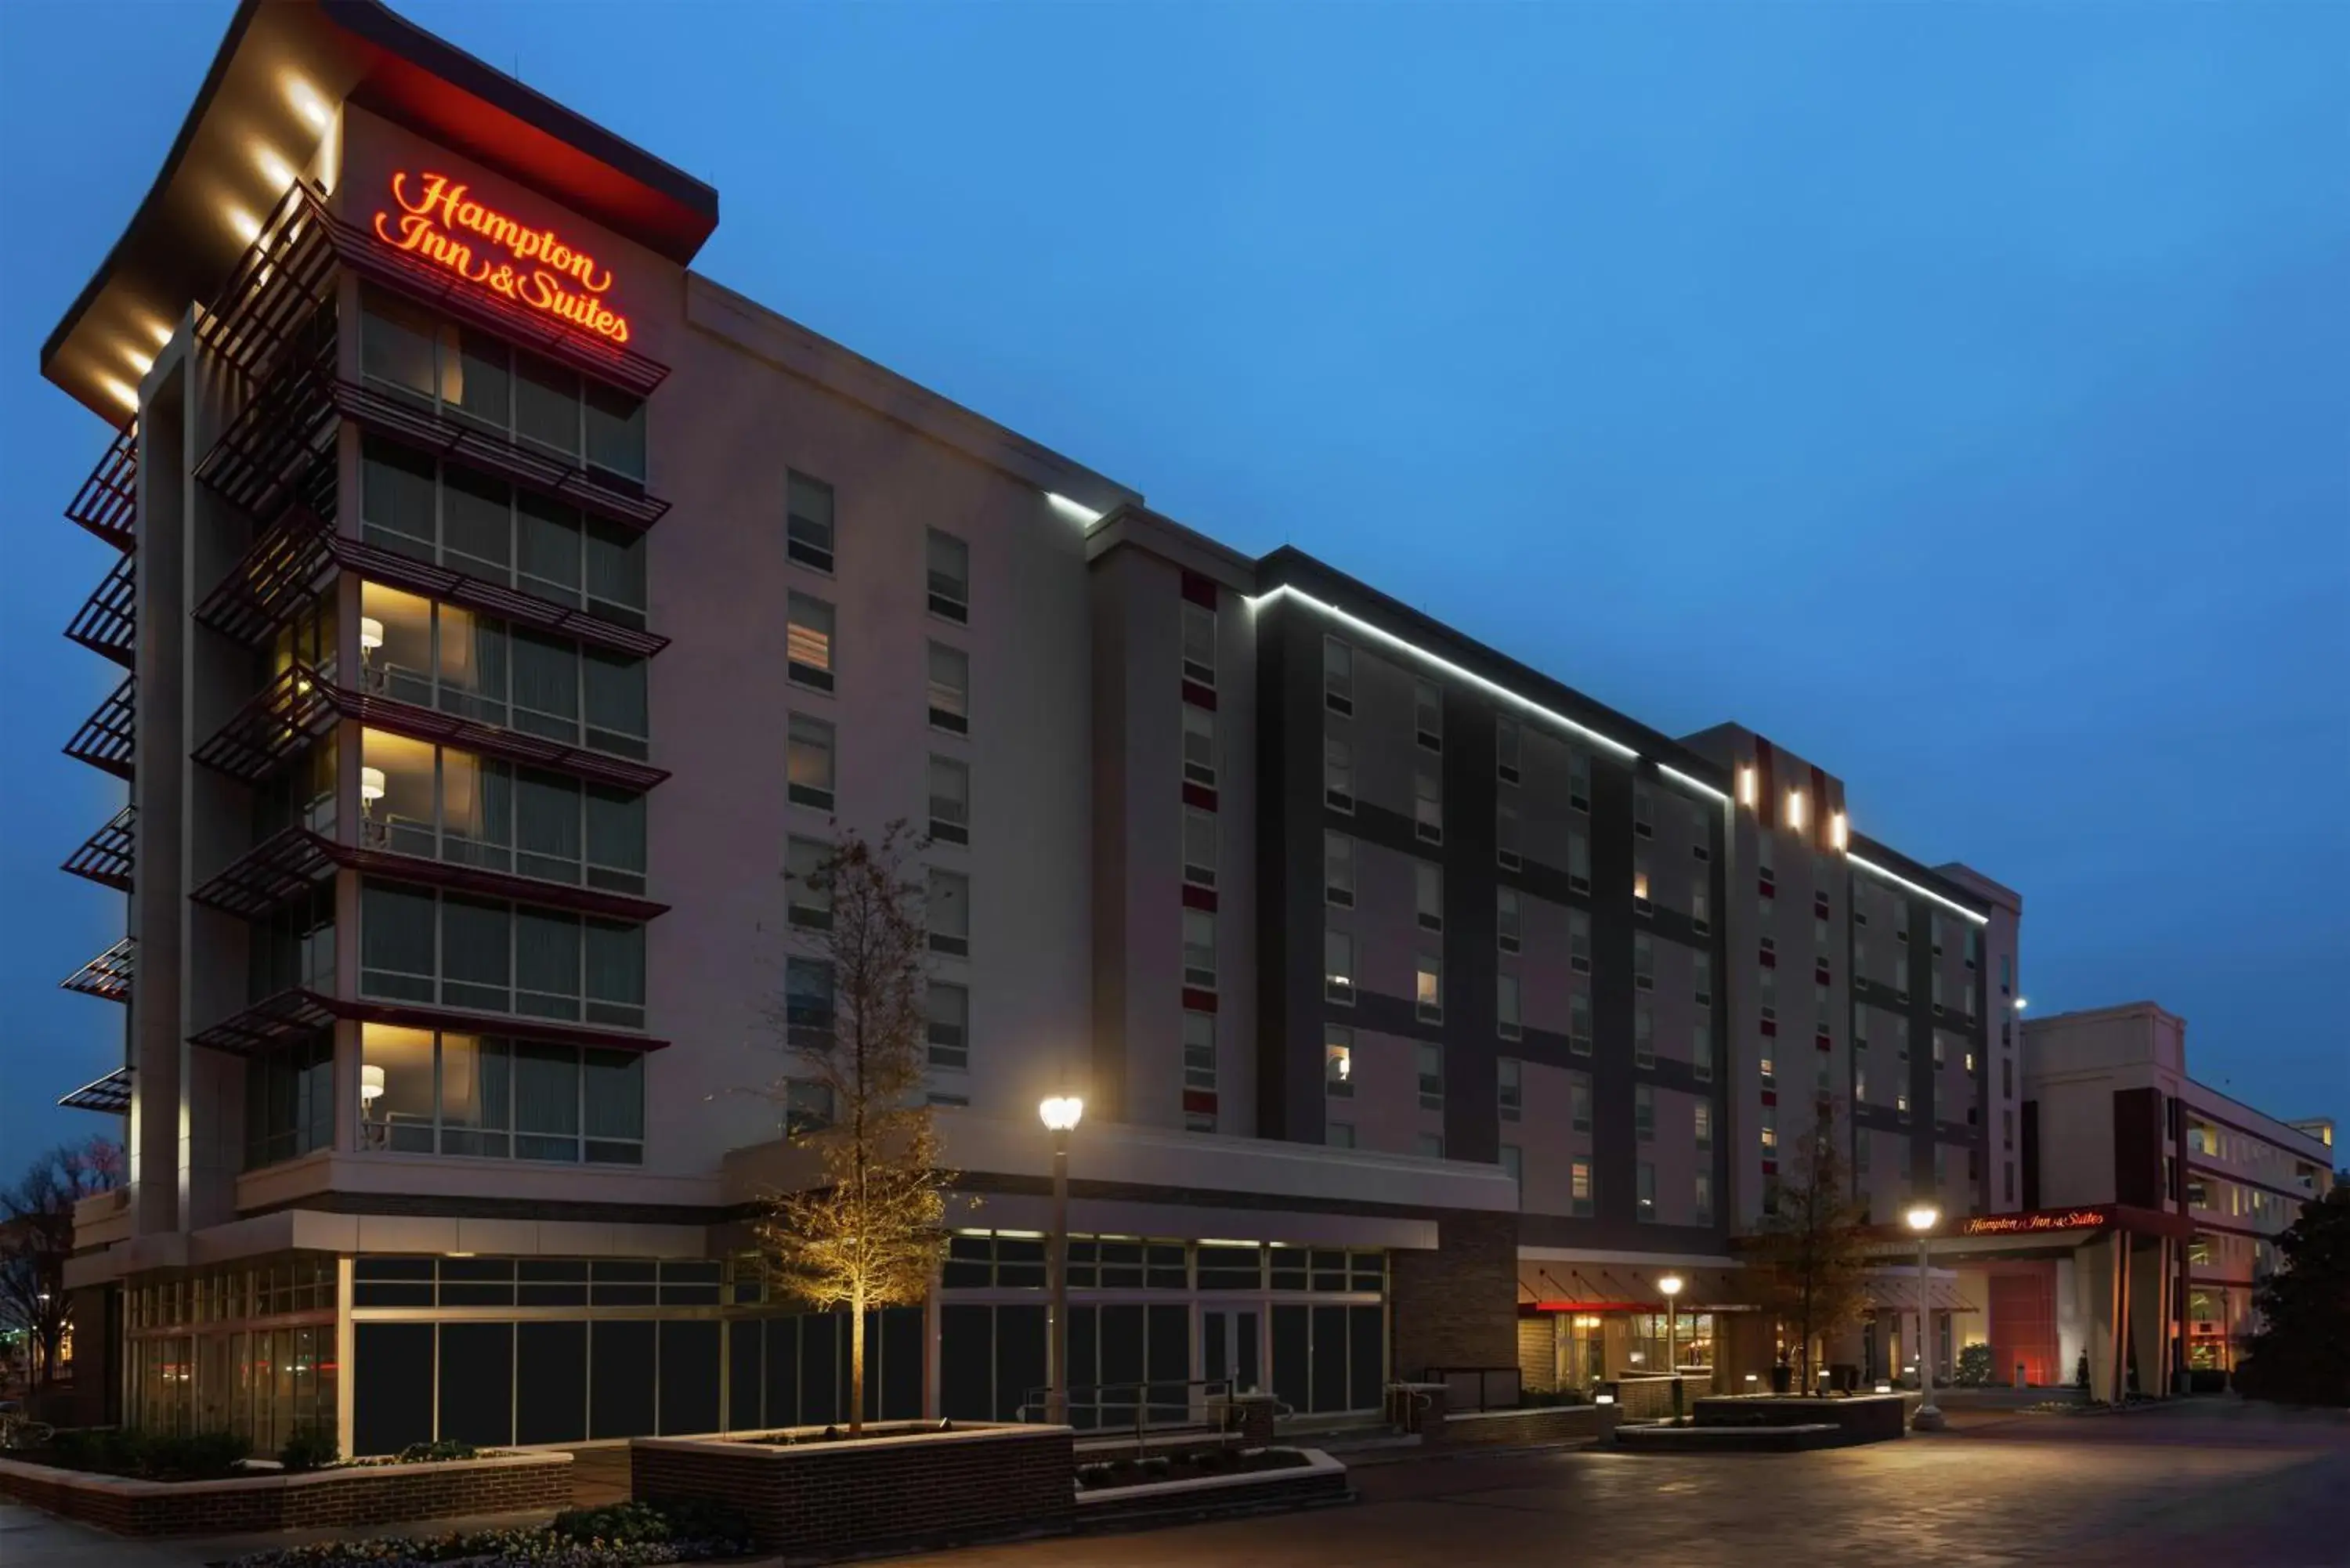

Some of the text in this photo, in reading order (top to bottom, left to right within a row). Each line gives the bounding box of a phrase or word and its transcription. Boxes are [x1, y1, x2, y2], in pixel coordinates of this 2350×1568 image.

[374, 211, 630, 342] Inn & Suites
[392, 172, 613, 292] Hampton
[1964, 1216, 2023, 1234] Hampton
[2023, 1215, 2055, 1229] Inn
[2066, 1211, 2103, 1226] Suites
